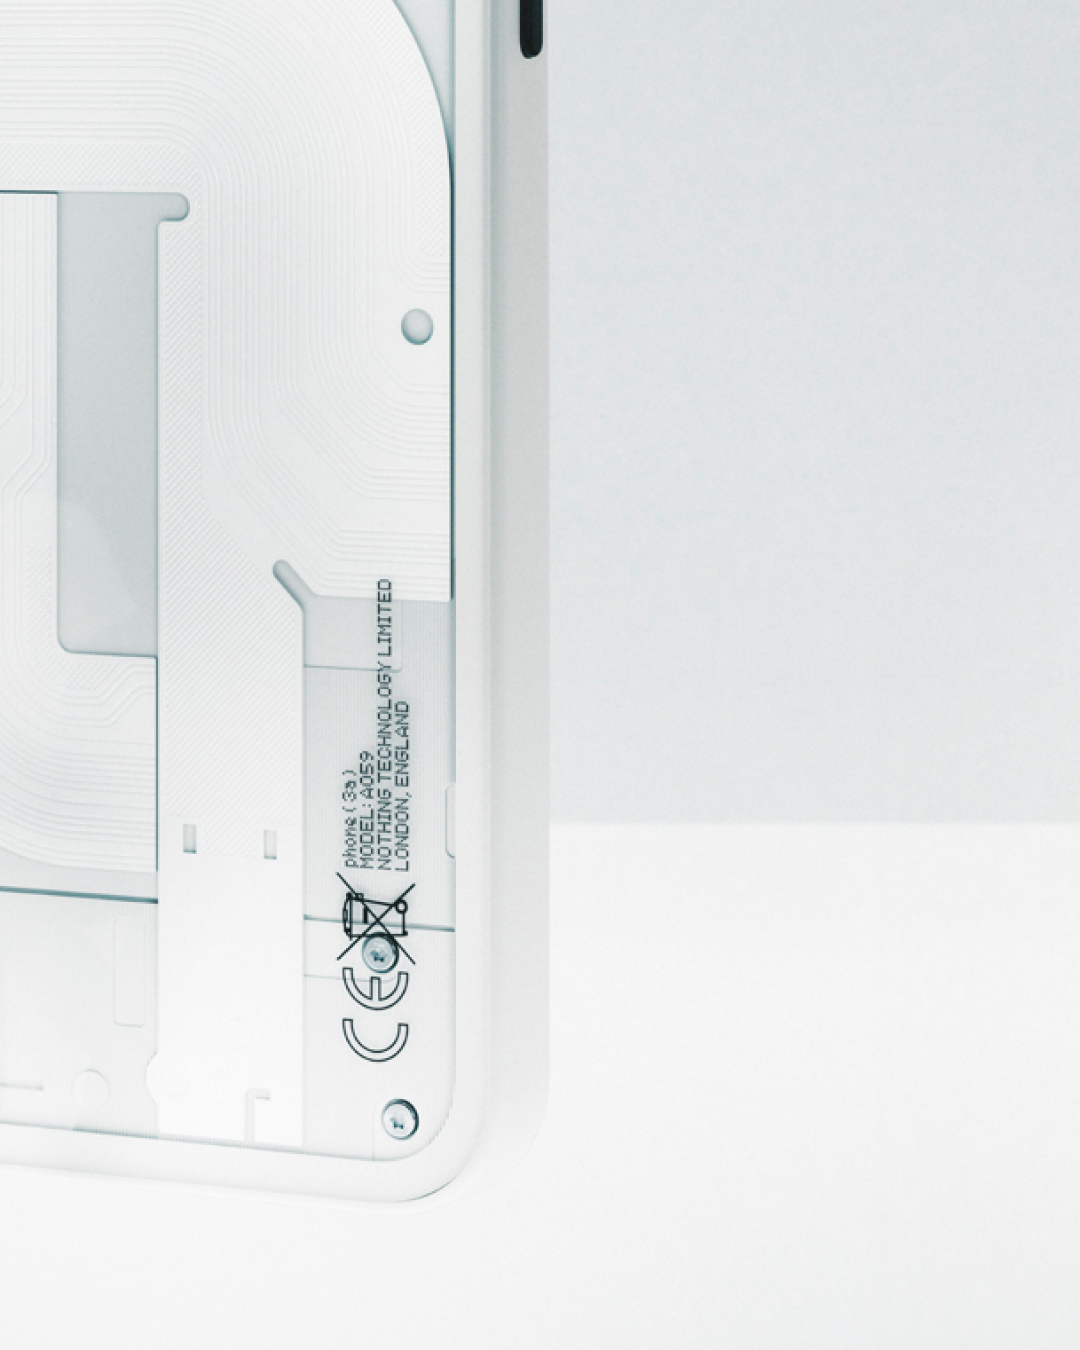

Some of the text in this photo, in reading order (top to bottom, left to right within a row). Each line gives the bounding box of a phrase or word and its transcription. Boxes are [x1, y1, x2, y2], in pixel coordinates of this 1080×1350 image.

[377, 578, 392, 870] NOTHING TECHNOLOGY LIMITED
[342, 816, 358, 868] phone
[359, 751, 374, 869] MODEL: A059
[395, 701, 411, 871] LONDON, ENGLAND
[342, 967, 409, 1062] CE
